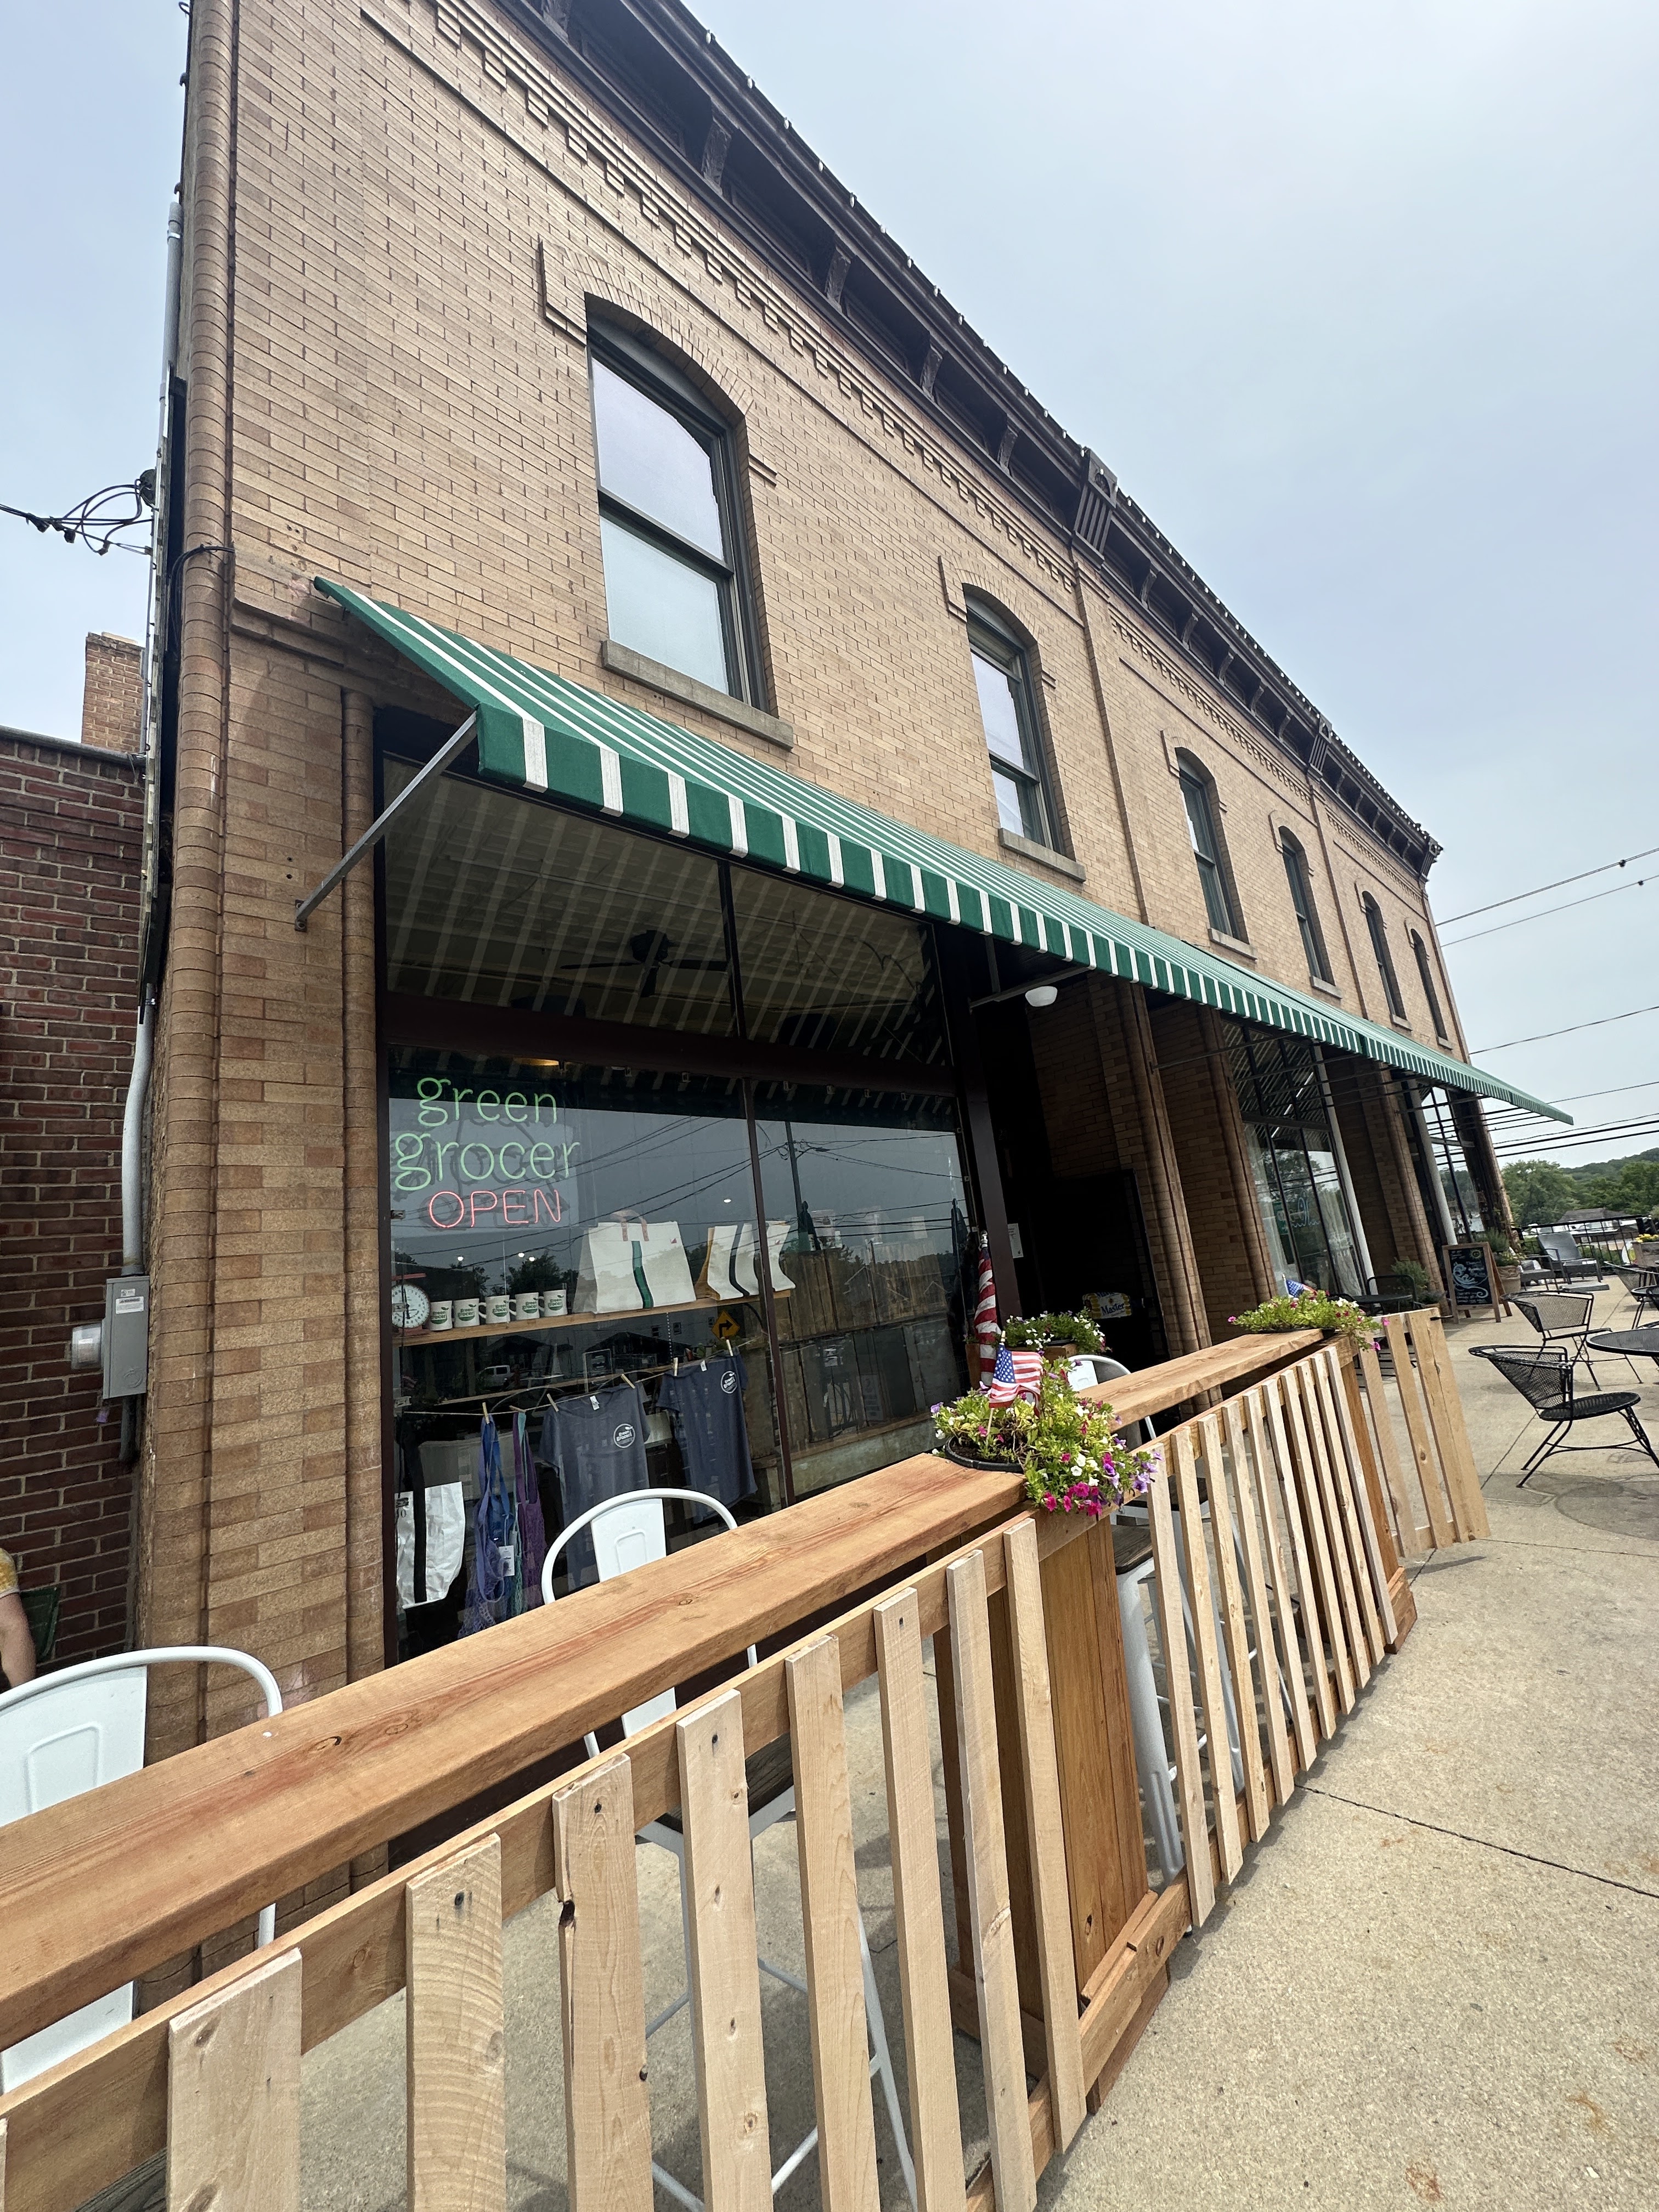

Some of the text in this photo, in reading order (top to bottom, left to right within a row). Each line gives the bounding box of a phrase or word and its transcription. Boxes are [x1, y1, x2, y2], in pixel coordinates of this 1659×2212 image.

[417, 1077, 557, 1127] green
[394, 1133, 580, 1191] grocer
[429, 1189, 561, 1228] OPEN
[1101, 1303, 1125, 1316] Master
